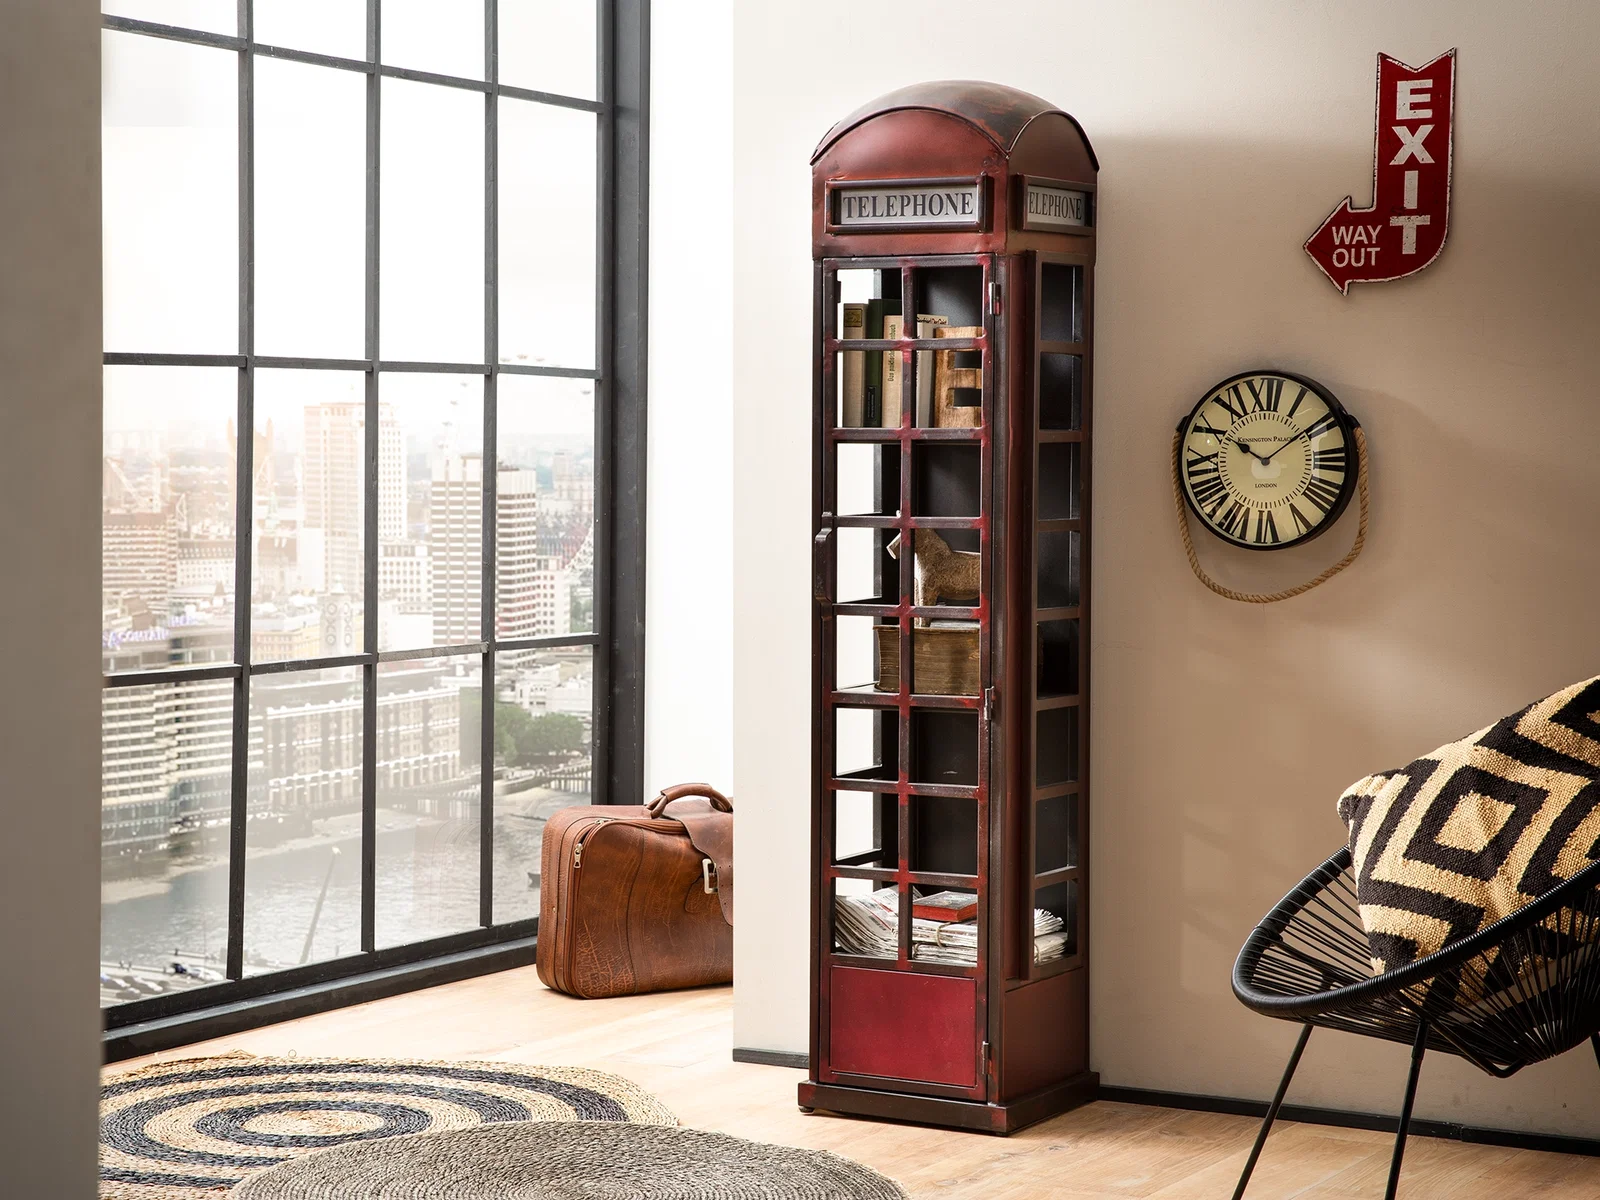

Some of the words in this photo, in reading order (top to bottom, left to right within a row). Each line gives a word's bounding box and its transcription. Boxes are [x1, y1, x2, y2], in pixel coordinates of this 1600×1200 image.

[1389, 79, 1435, 254] EXIT
[843, 192, 973, 218] TELEPHONE
[1028, 192, 1082, 220] ELEPHONE
[1332, 225, 1382, 245] WAY
[1332, 248, 1380, 268] OUT
[1211, 383, 1250, 425] XI
[1243, 378, 1286, 412] XII
[1286, 386, 1310, 419] I
[1191, 411, 1227, 445] X
